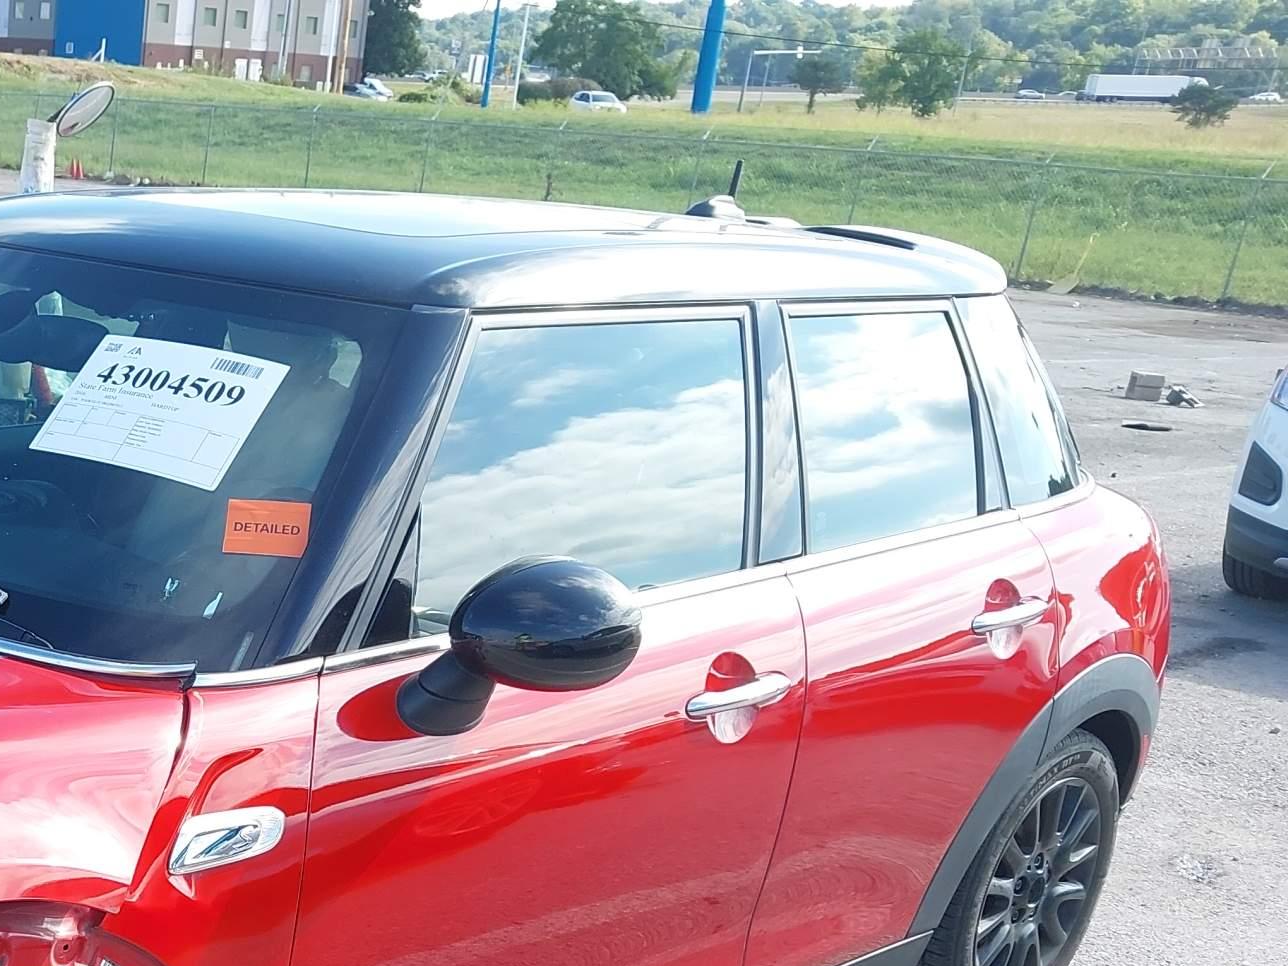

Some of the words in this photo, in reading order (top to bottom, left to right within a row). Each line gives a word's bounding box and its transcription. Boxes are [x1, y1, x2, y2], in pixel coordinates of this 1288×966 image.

[79, 381, 97, 391] State
[97, 385, 118, 394] Farm
[118, 387, 154, 400] Insurance
[96, 362, 246, 407] 43004509
[233, 520, 301, 536] DETAILED
